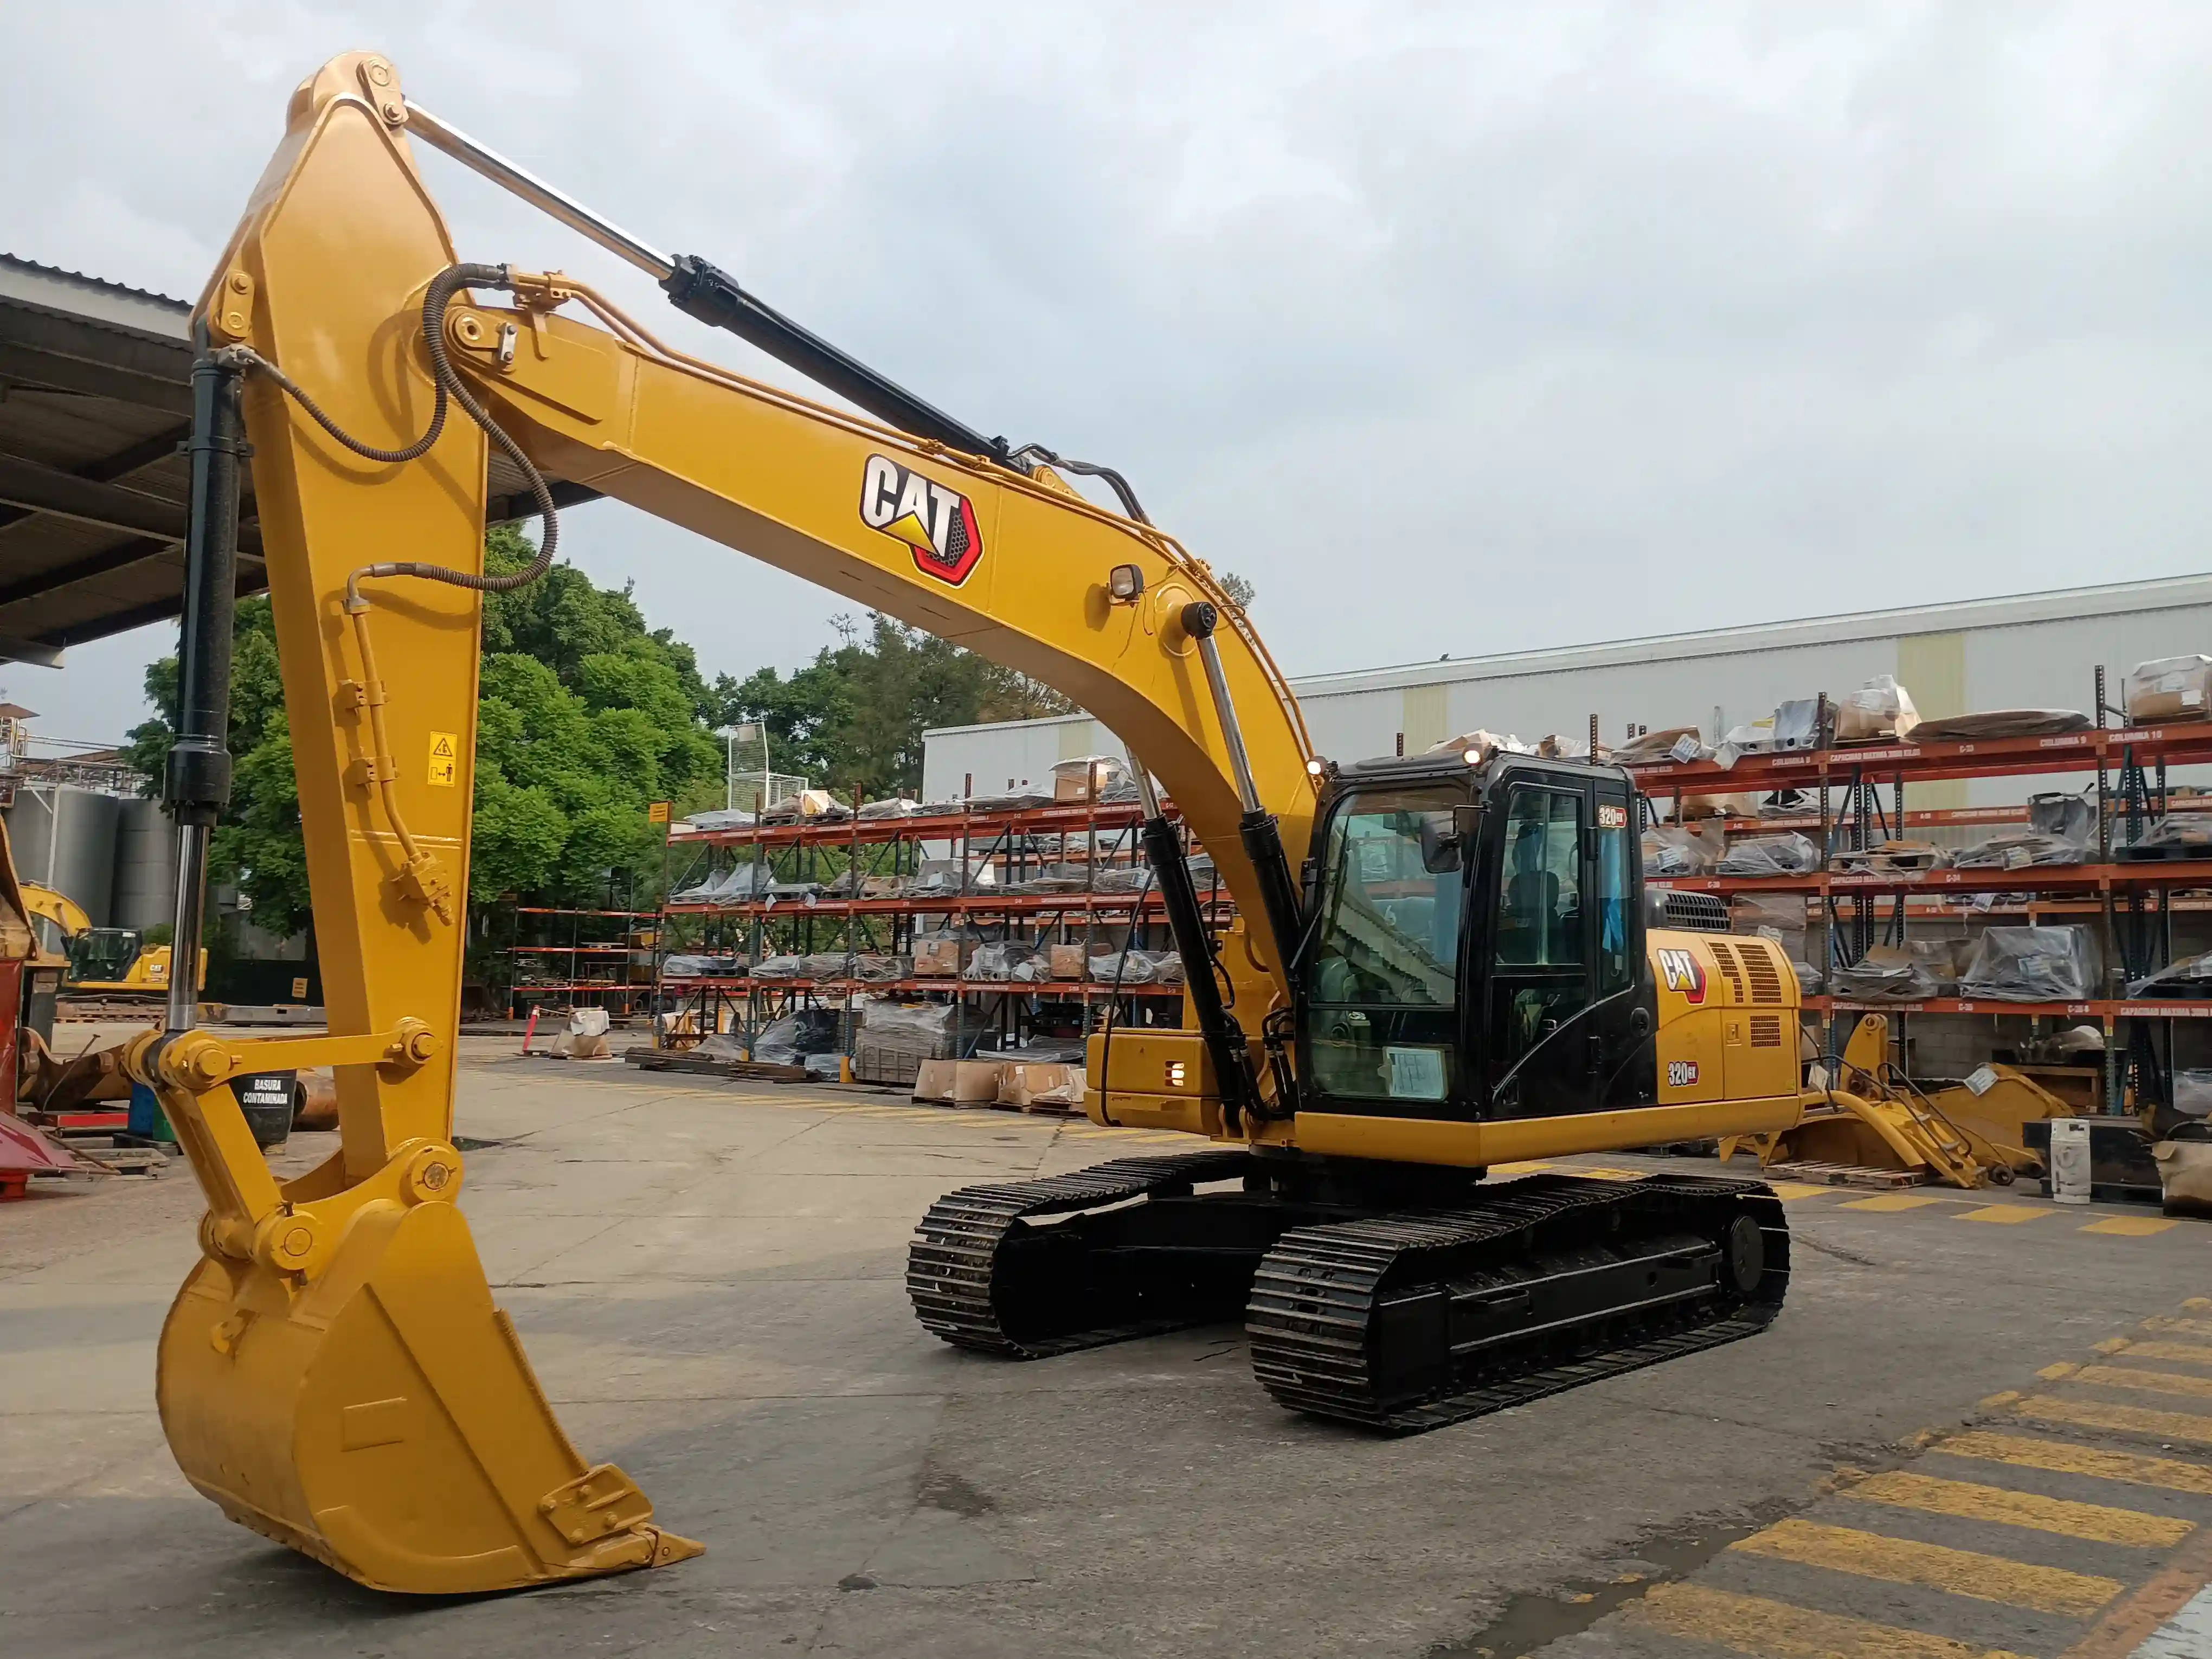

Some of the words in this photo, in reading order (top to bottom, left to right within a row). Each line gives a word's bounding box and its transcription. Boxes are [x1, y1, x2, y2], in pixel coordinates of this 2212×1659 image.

[863, 456, 960, 557] CAT
[1598, 807, 1616, 826] 320
[1658, 949, 1697, 990] CAT
[1668, 1062, 1688, 1085] 320
[254, 1079, 281, 1091] BASURA
[243, 1092, 288, 1104] CONTAMINADA
